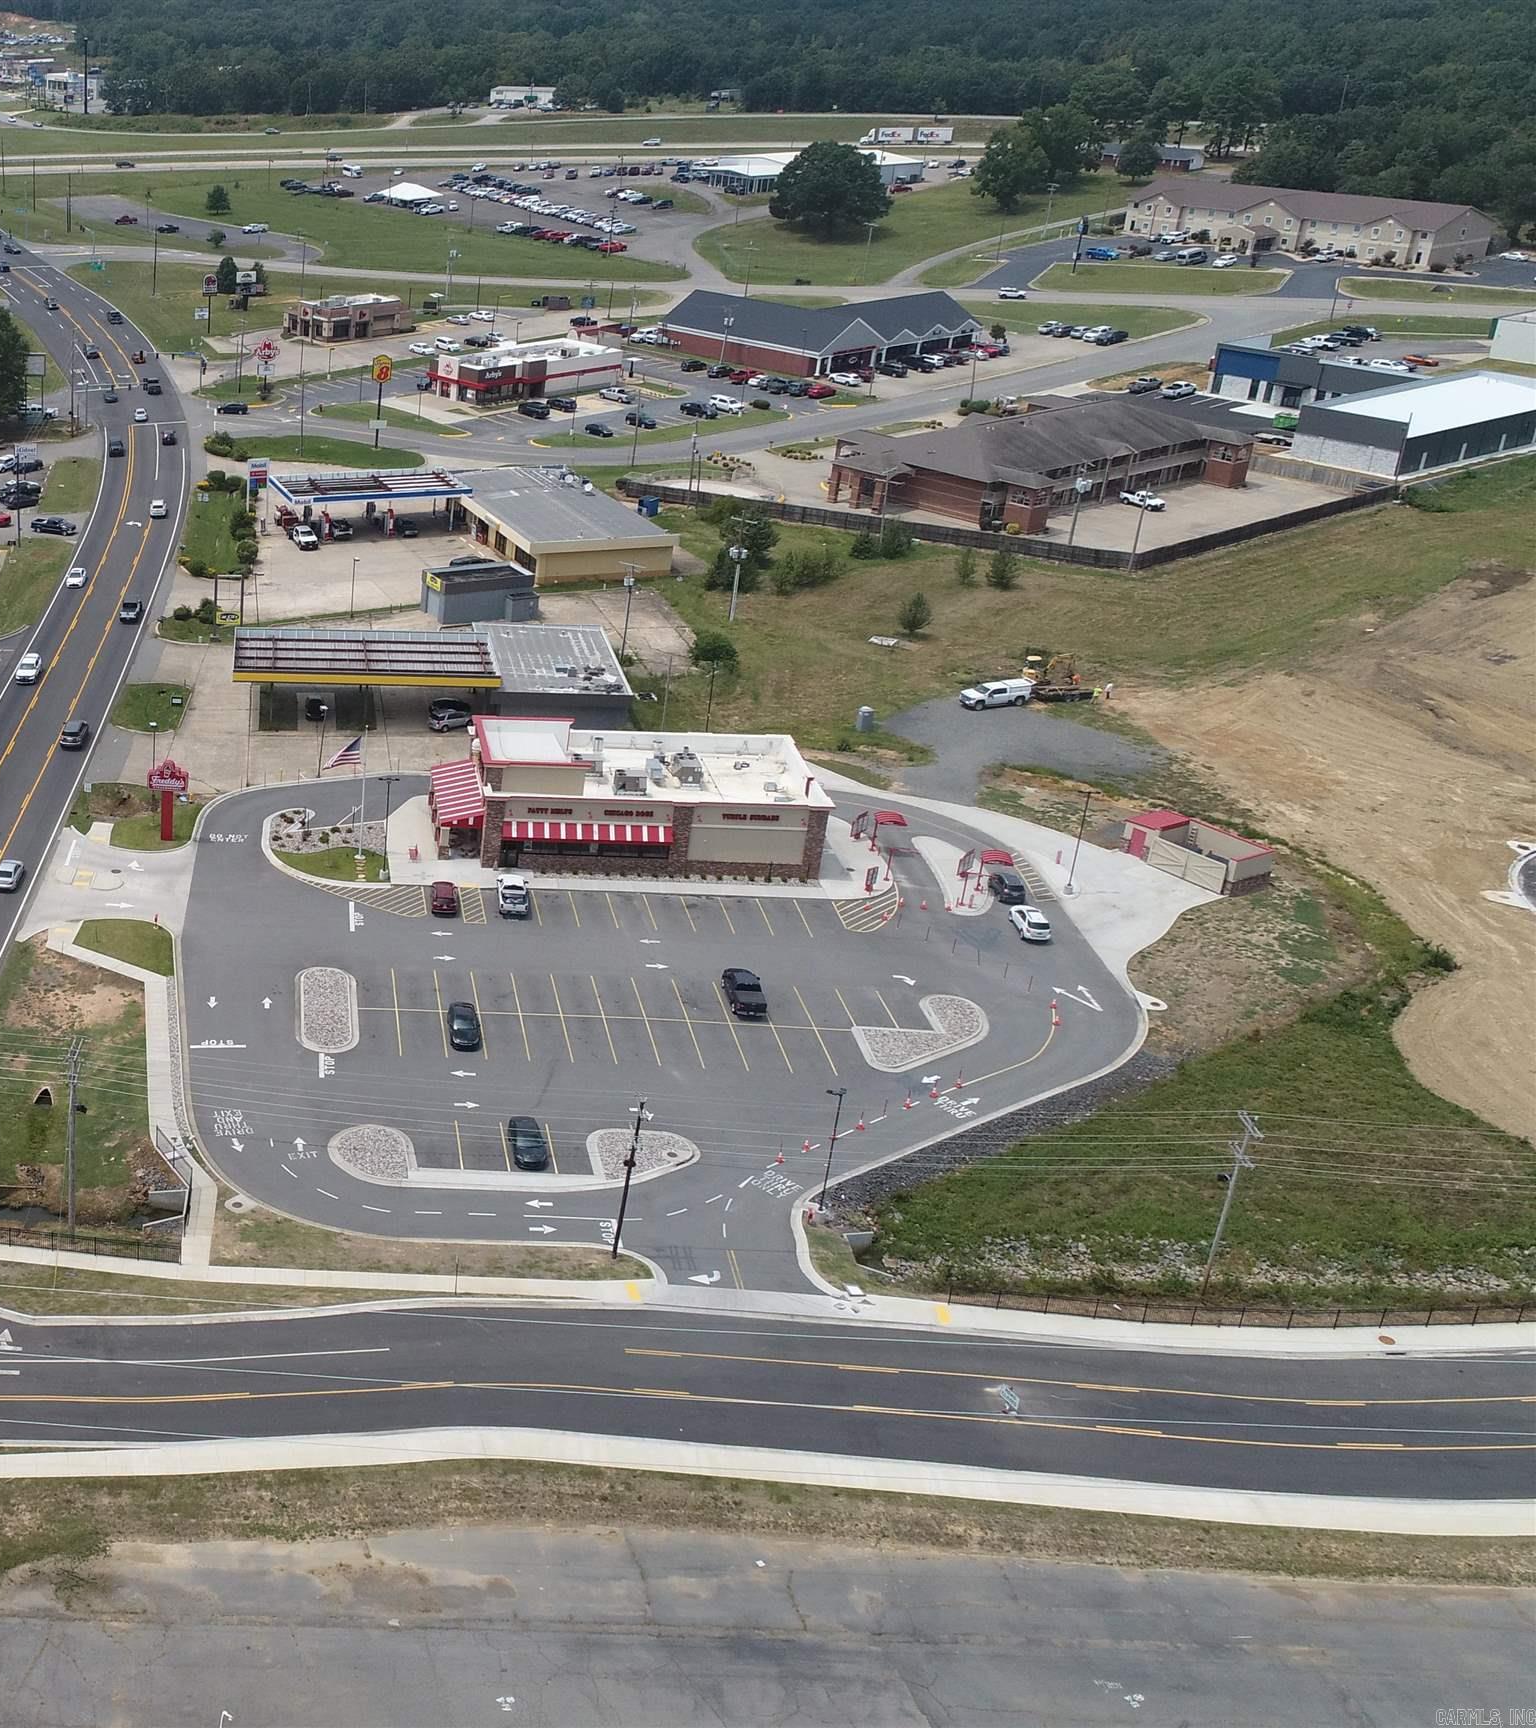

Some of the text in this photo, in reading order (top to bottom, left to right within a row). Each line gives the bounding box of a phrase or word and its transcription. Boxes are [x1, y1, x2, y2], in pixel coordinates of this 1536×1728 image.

[377, 366, 389, 380] 8
[484, 369, 503, 379] Arby's
[149, 775, 185, 788] Freddy's
[604, 809, 634, 817] CHICAGO
[354, 911, 364, 926] STOP
[325, 1055, 336, 1075] STOP
[213, 1109, 242, 1118] EXIT
[933, 1101, 967, 1119] THRU
[937, 1096, 977, 1117] DRIVE
[214, 1121, 248, 1130] THRU
[214, 1127, 255, 1137] DRIVE
[288, 1150, 320, 1160] EXIT
[760, 1175, 794, 1195] THRU
[764, 1169, 804, 1193] DRIVE
[751, 1179, 786, 1199] ONLY
[599, 1221, 615, 1245] STOP
